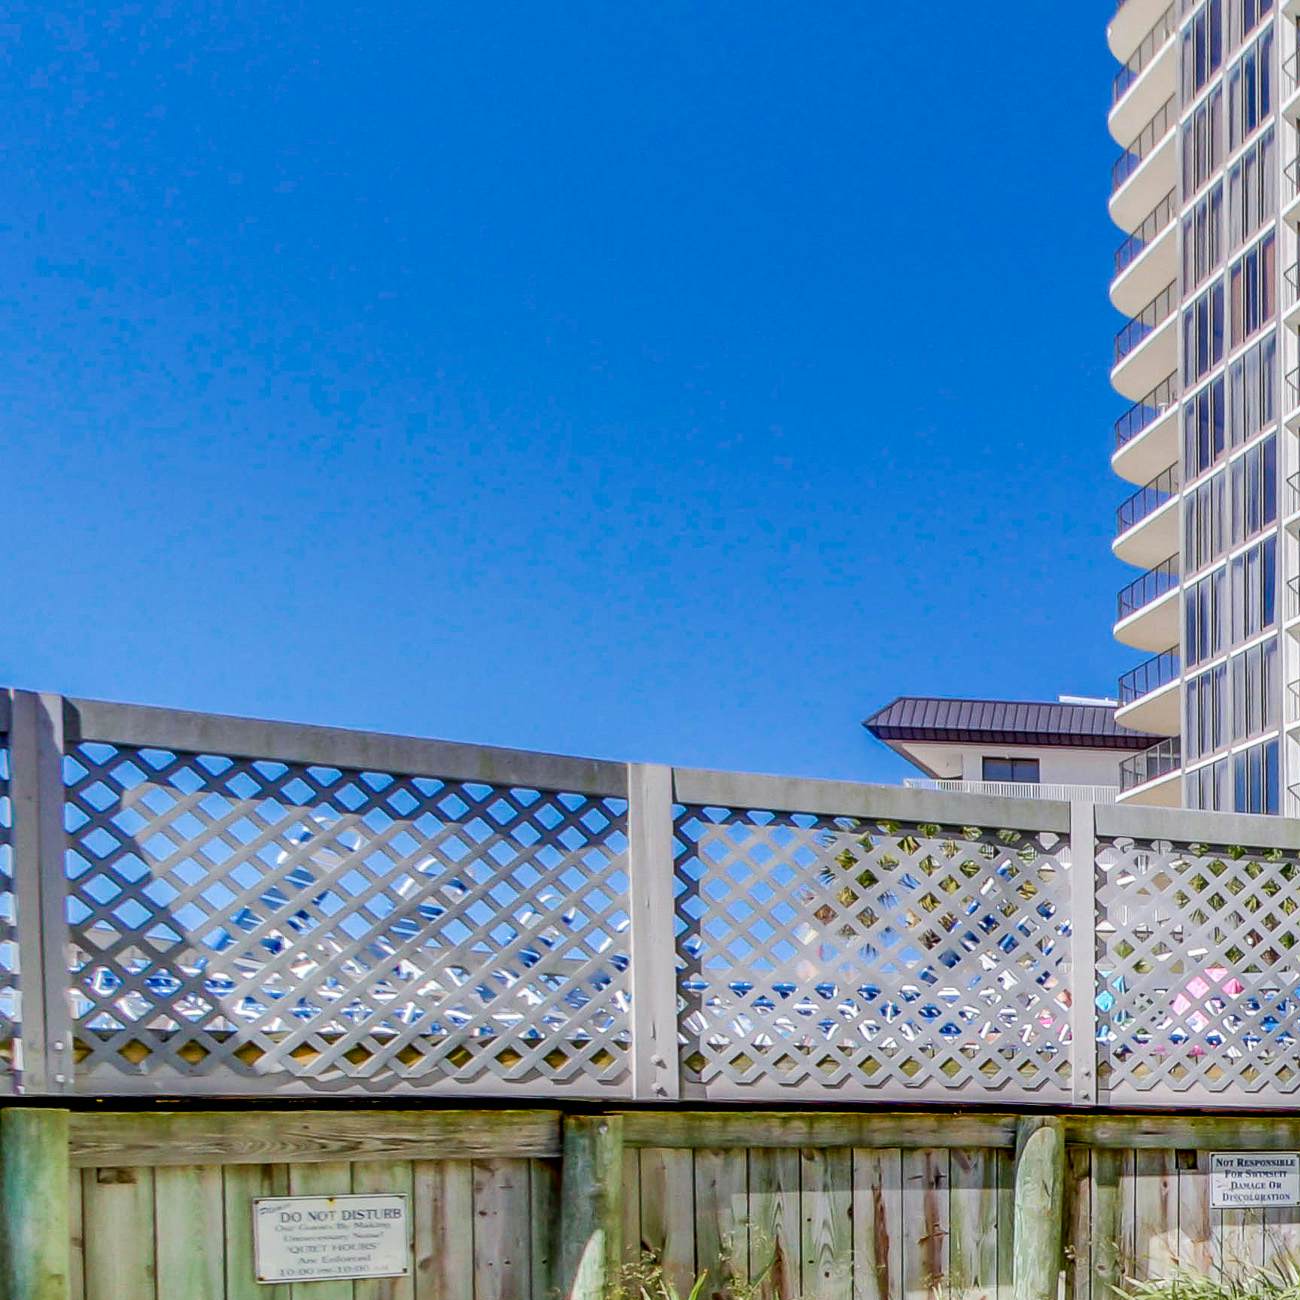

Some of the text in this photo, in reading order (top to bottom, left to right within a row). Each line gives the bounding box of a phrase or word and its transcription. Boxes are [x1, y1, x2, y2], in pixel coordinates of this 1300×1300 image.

[280, 1209, 402, 1223] DO NOT DISTURB
